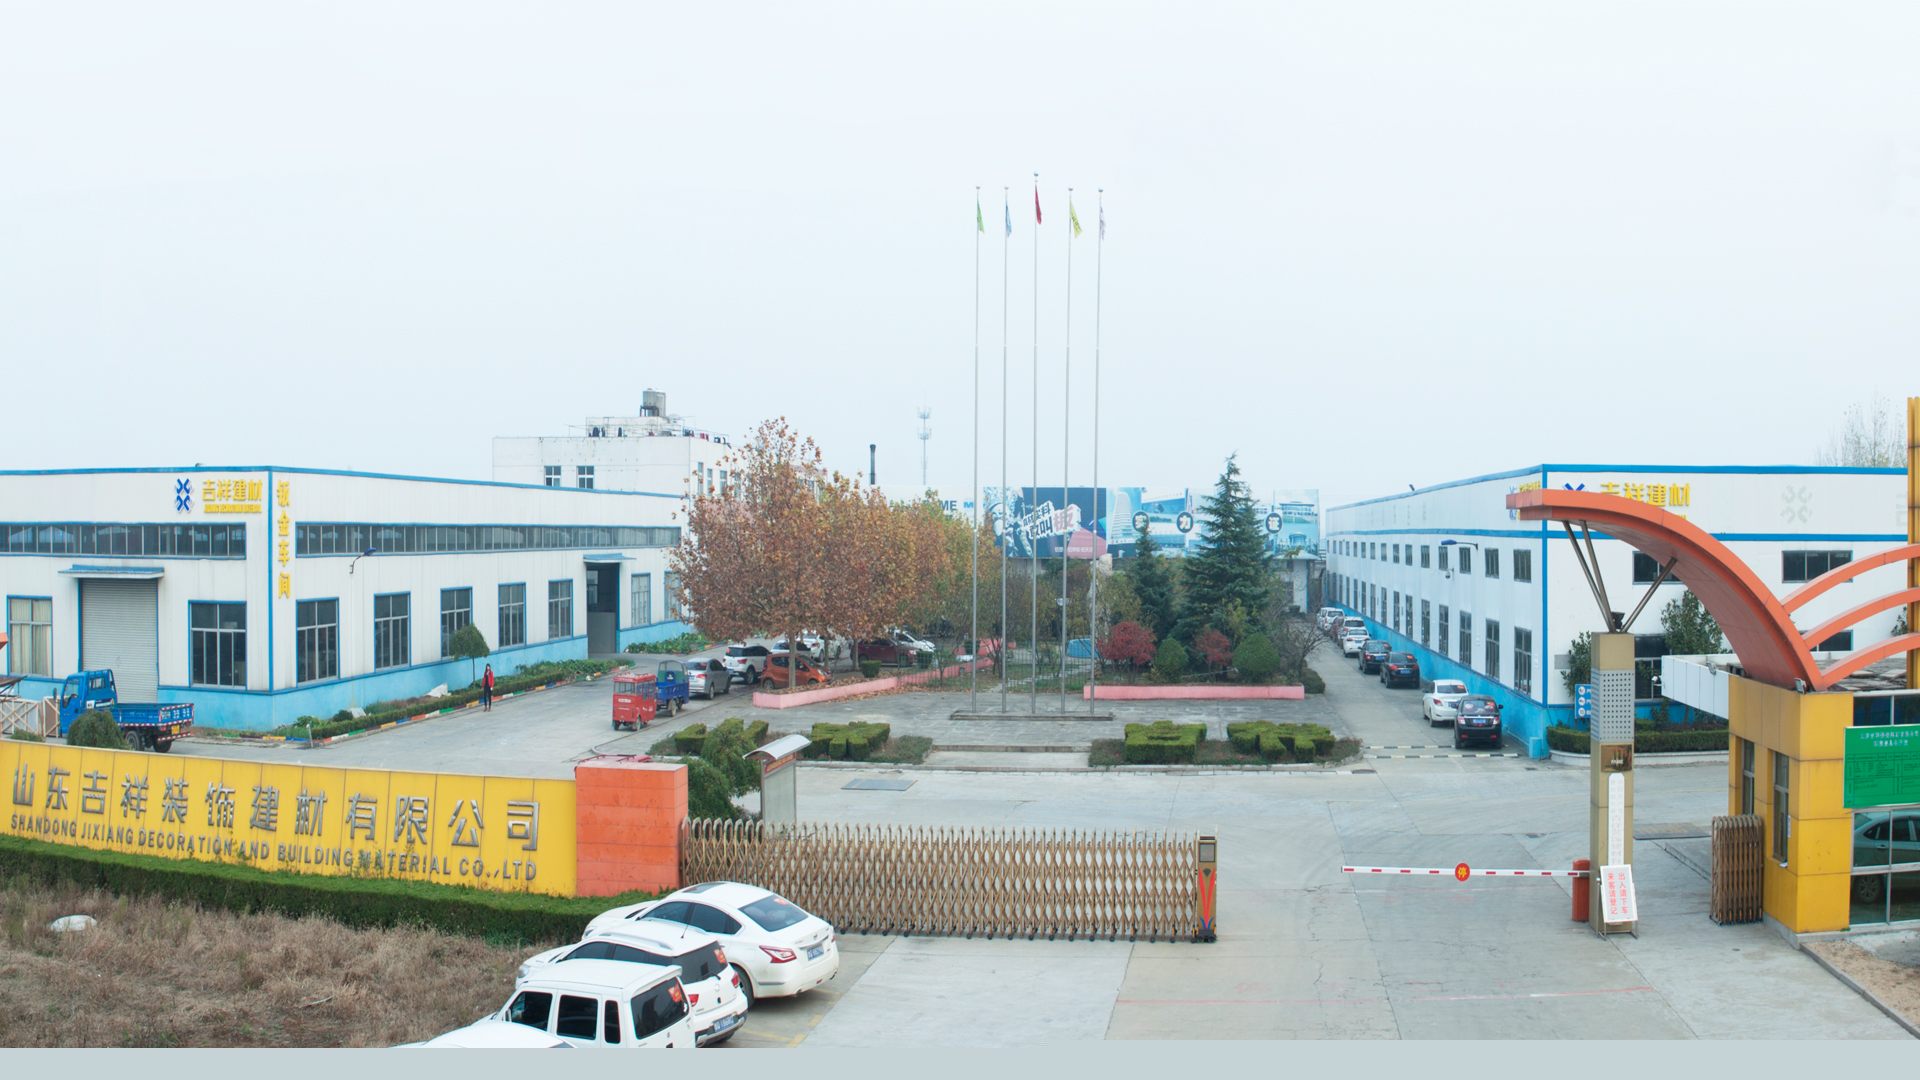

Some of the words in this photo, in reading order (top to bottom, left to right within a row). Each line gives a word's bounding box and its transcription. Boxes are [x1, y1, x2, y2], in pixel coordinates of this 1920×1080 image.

[202, 479, 262, 501] 吉祥建材
[12, 763, 540, 851] 山东吉祥装饰建材有限公司
[11, 813, 77, 837] SHANDONG
[81, 822, 133, 845] JIXIANG
[138, 829, 232, 856] DECORATION
[238, 839, 270, 859] AND
[278, 843, 352, 866] BUILDING
[359, 849, 451, 875] MATERIAL
[1458, 867, 1467, 878] 停
[1607, 872, 1618, 915] 来客请登记
[1618, 872, 1629, 915] 出入请下车
